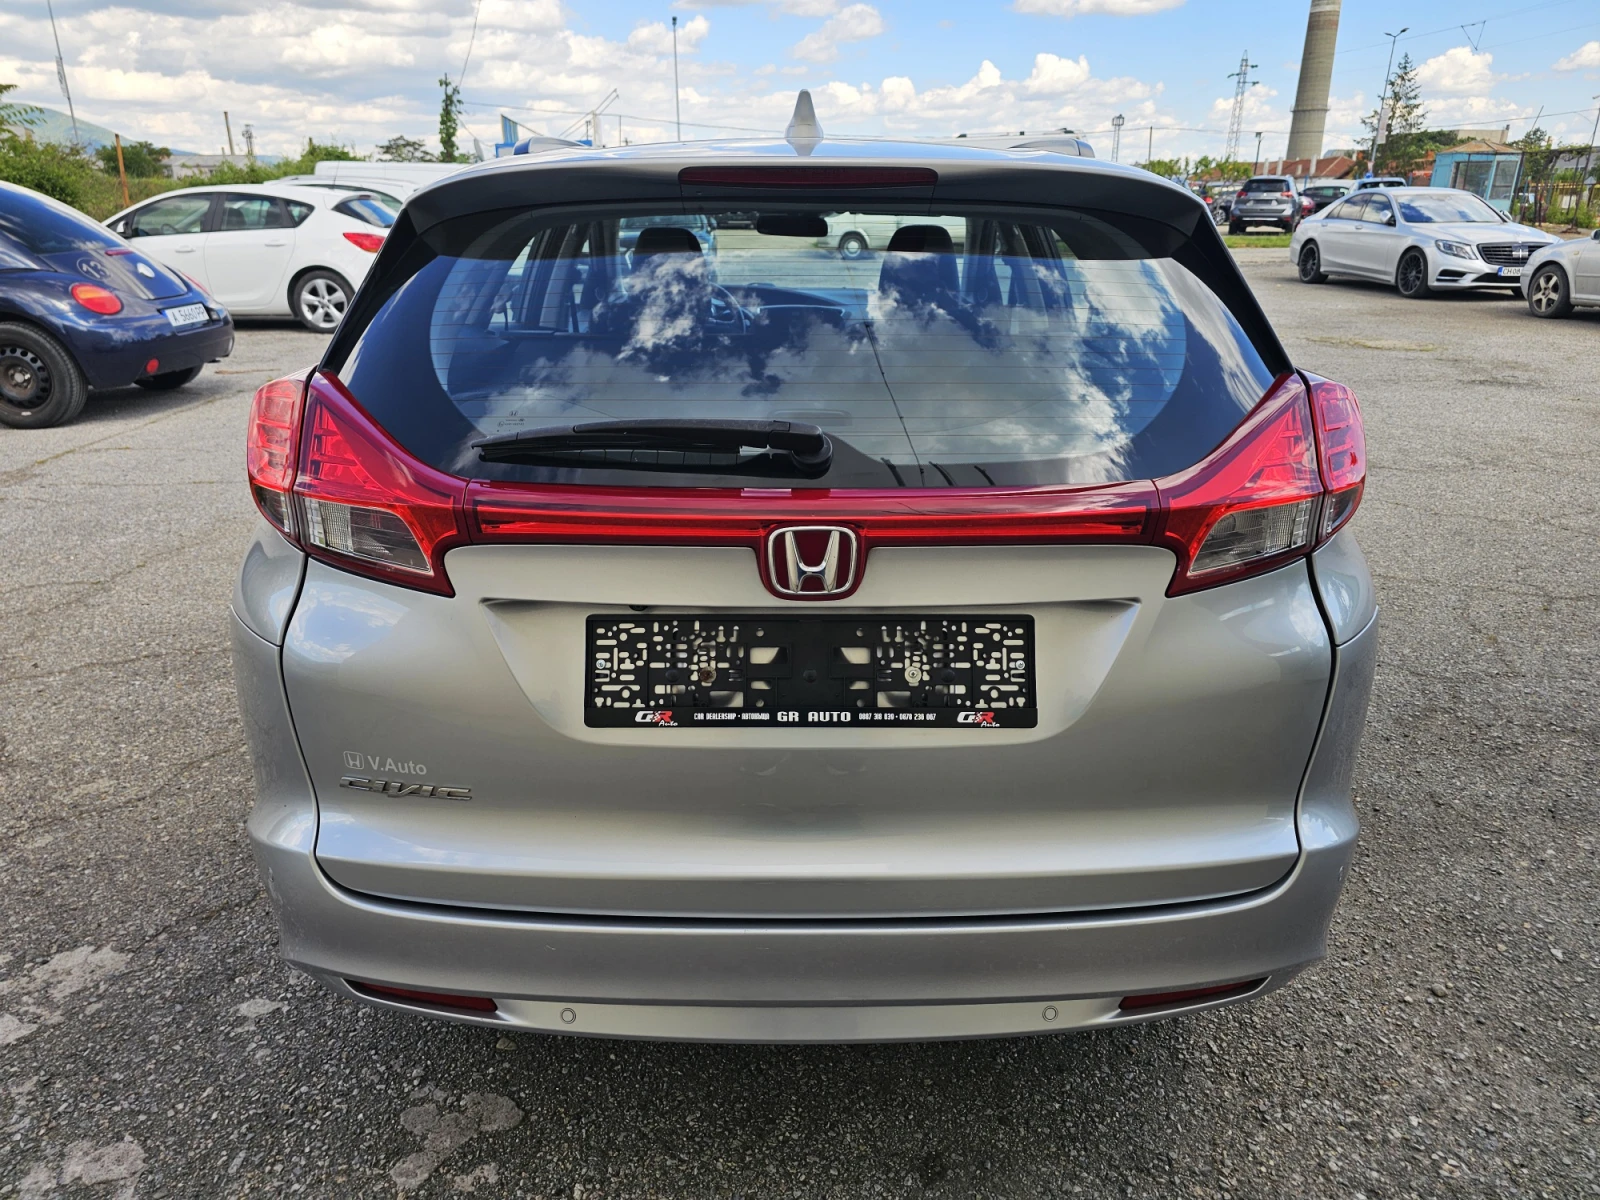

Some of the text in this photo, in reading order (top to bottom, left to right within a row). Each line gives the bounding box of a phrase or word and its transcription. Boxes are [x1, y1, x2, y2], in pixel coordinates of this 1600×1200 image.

[693, 712, 737, 720] CAR DEALERSHIP
[777, 711, 851, 722] GR AUTO
[658, 719, 679, 727] Auto
[980, 720, 1001, 728] Auto
[367, 755, 428, 775] V.Auto
[340, 775, 473, 801] CIVIC
